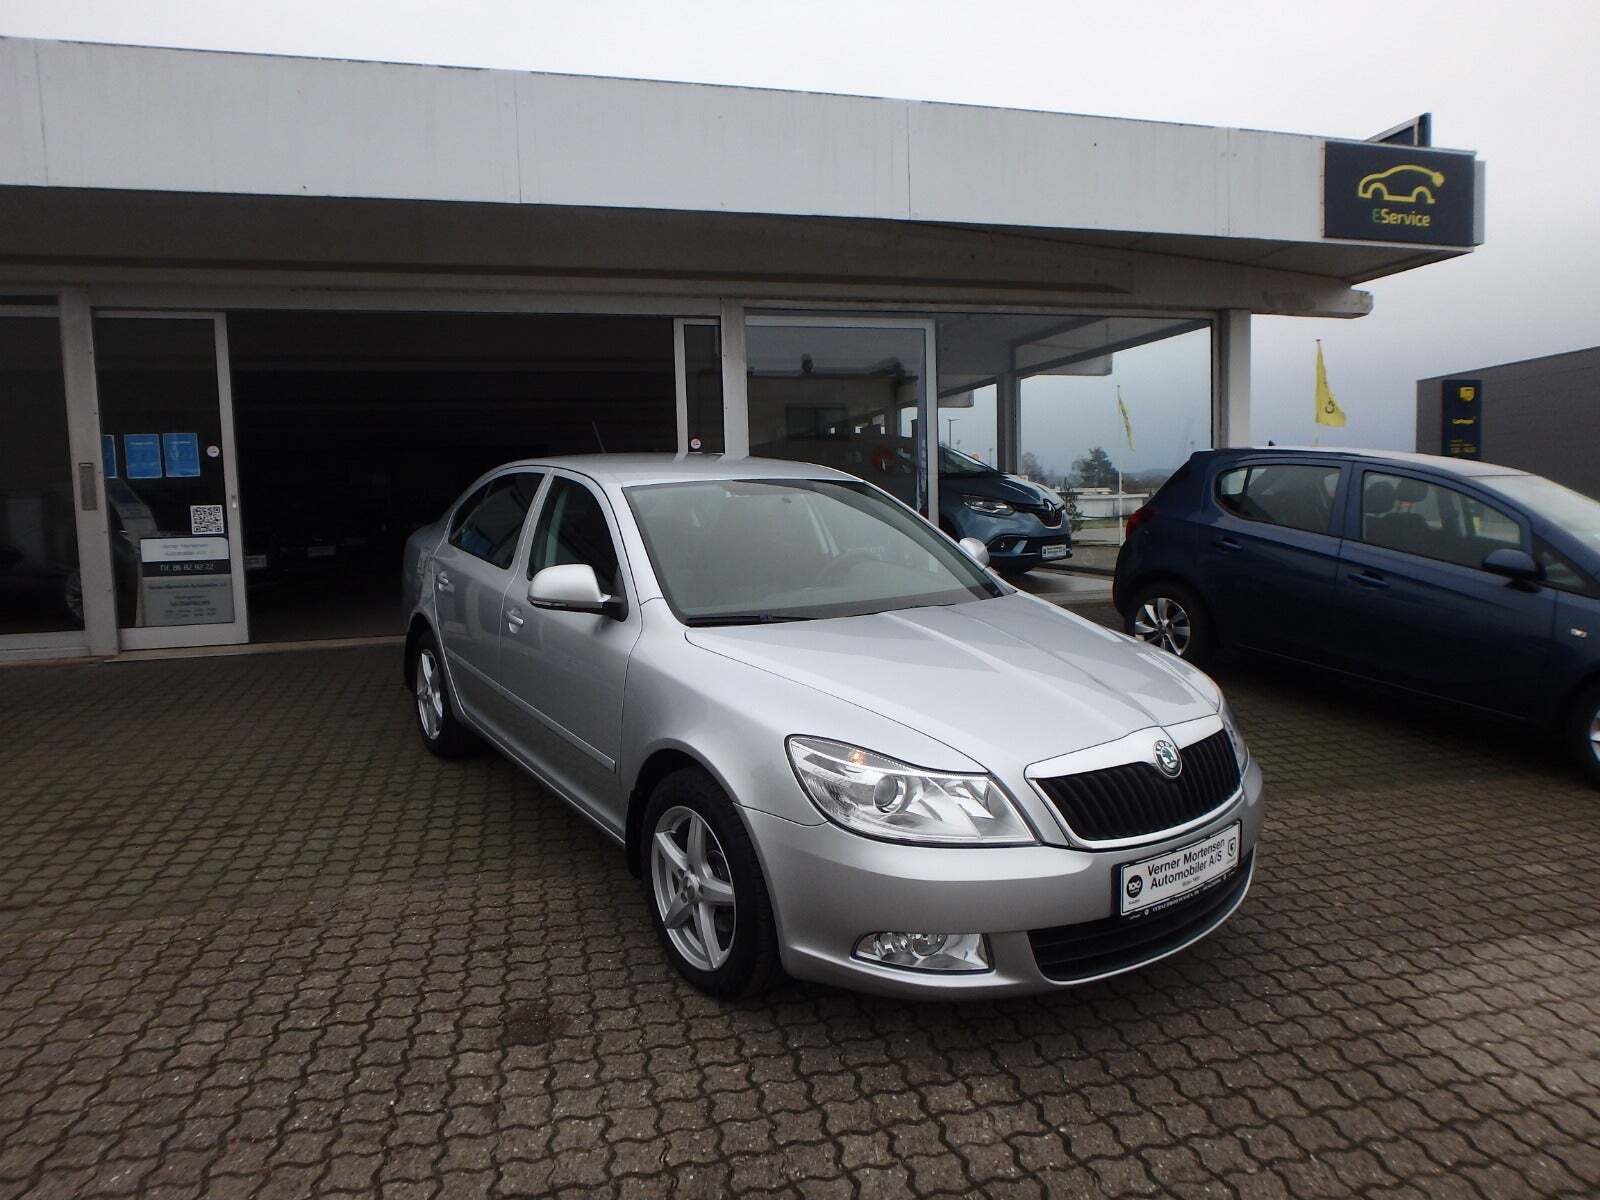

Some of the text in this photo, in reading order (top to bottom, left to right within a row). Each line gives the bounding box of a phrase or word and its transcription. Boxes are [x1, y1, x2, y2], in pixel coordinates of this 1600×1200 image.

[1372, 207, 1431, 227] EService
[1147, 839, 1225, 877] Verner Mortensen
[1150, 862, 1207, 890] Automobiler
[1209, 850, 1222, 868] A/S
